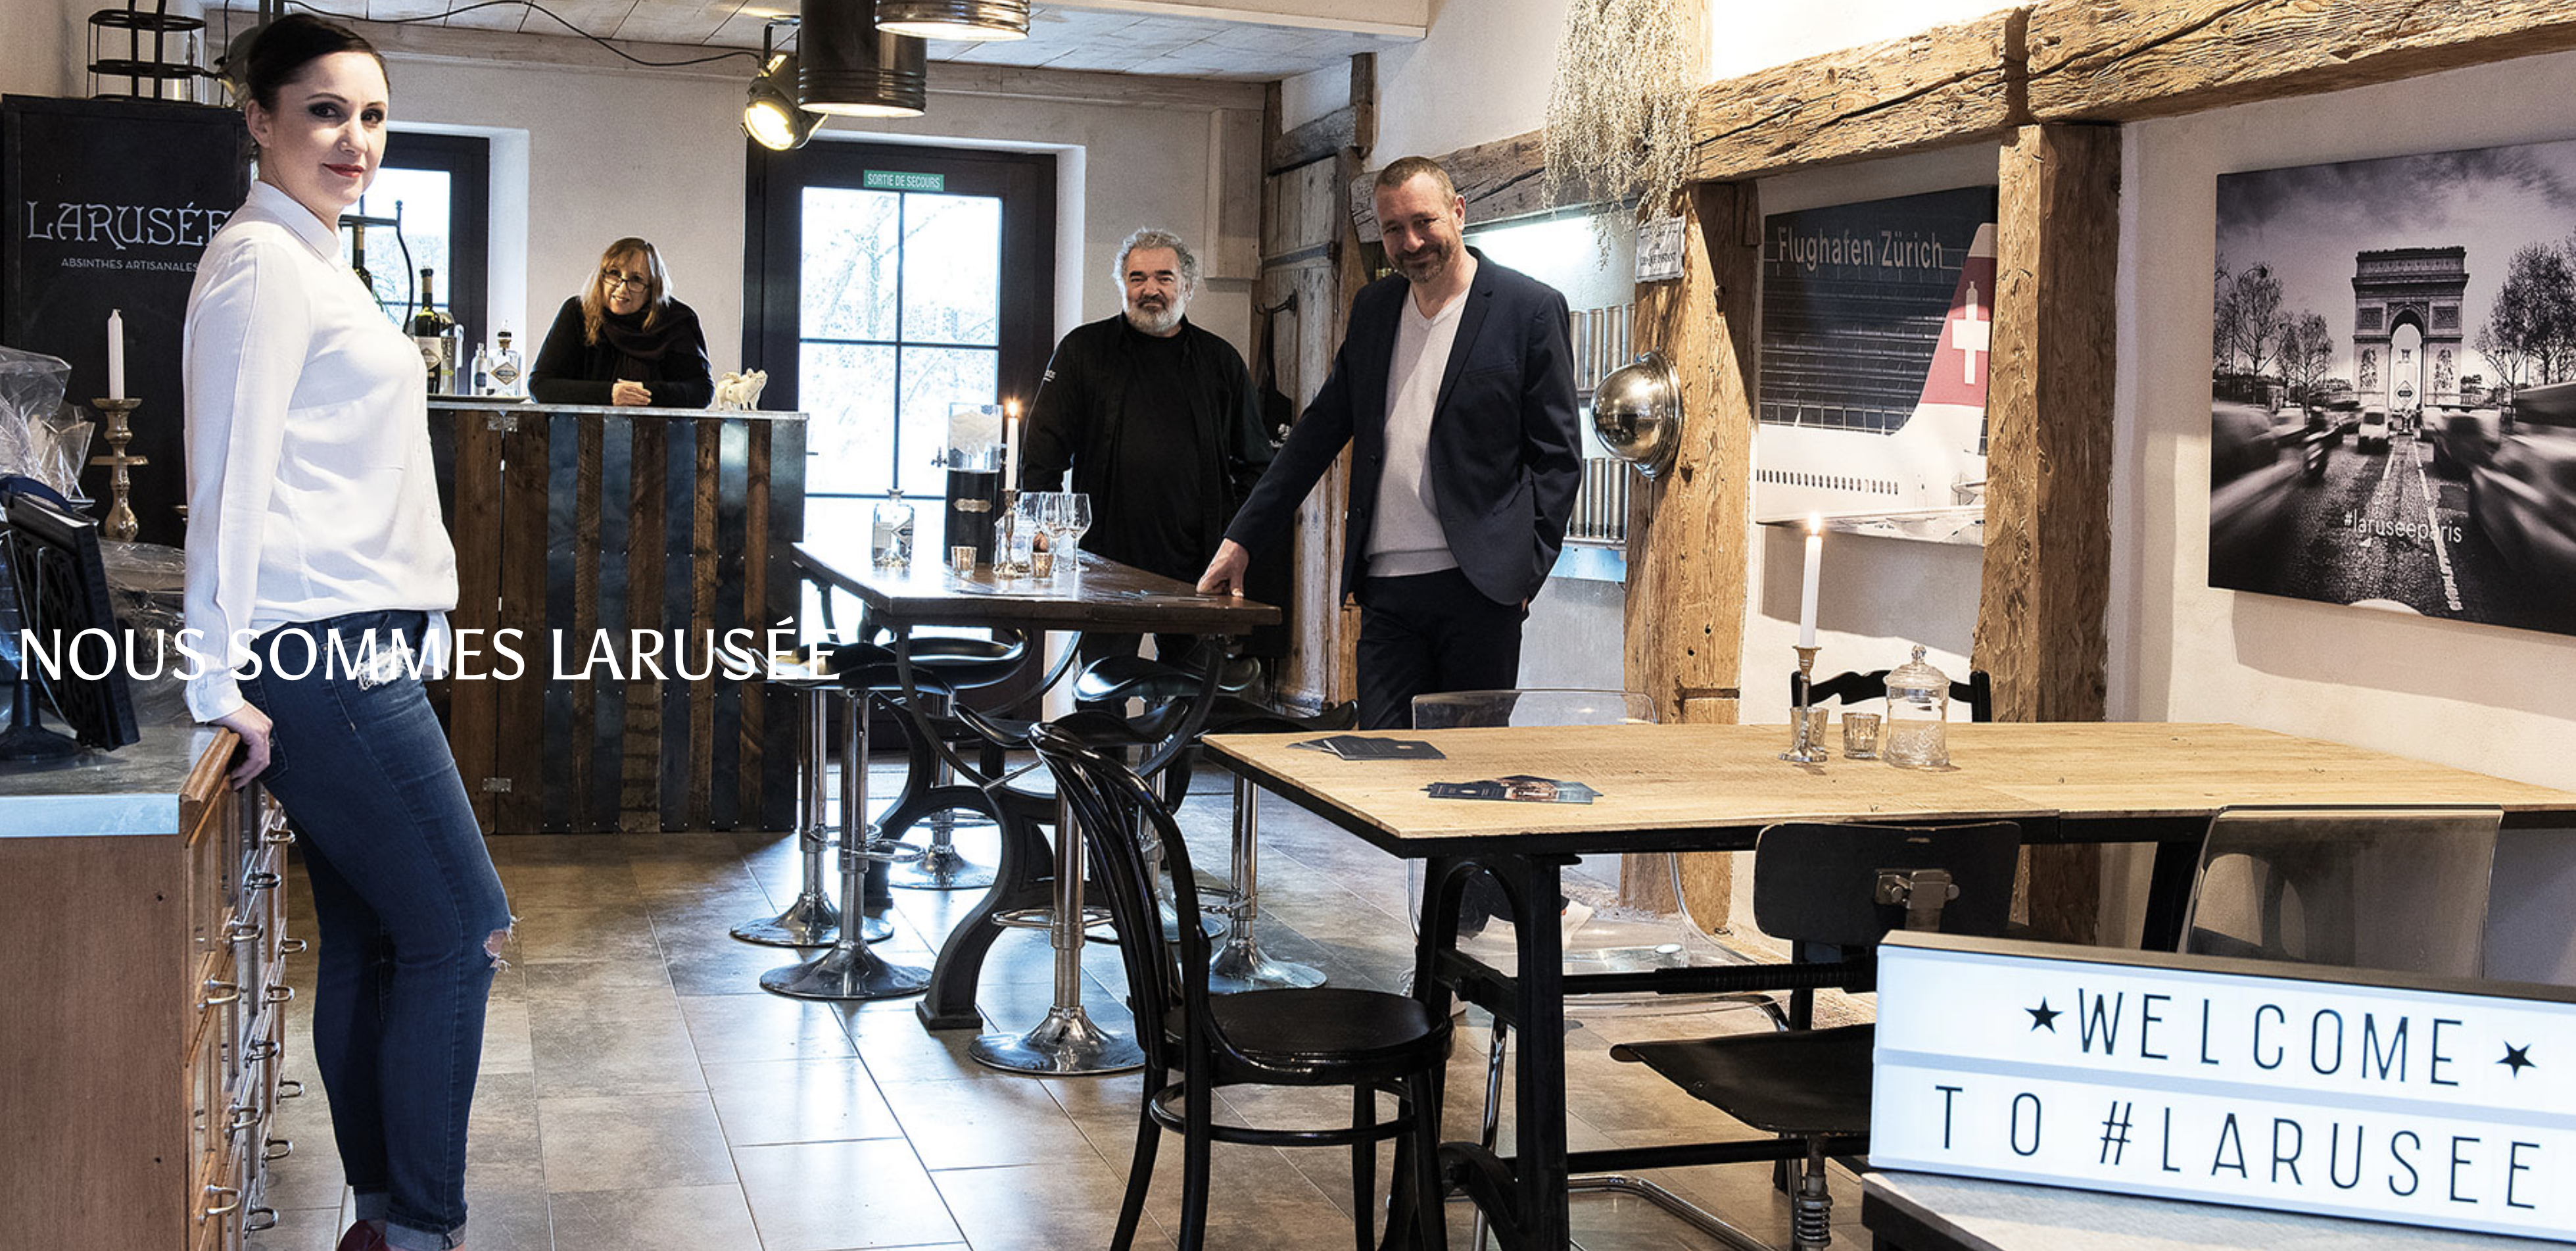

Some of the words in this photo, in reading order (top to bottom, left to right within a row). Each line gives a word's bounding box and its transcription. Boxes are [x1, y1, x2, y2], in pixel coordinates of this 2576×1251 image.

[867, 173, 894, 186] SORTIE
[895, 174, 905, 187] DE
[907, 175, 940, 189] SECOURS
[61, 258, 123, 270] ABSINTHES
[125, 260, 198, 272] ARTISANALES
[1778, 226, 1874, 272] Flughafen
[1881, 230, 1943, 268] Zürich
[2344, 508, 2462, 545] #laruseeparis
[2079, 988, 2462, 1086] WELCOME
[1935, 1085, 2041, 1156] TO
[2100, 1100, 2540, 1210] #LARUSEE
